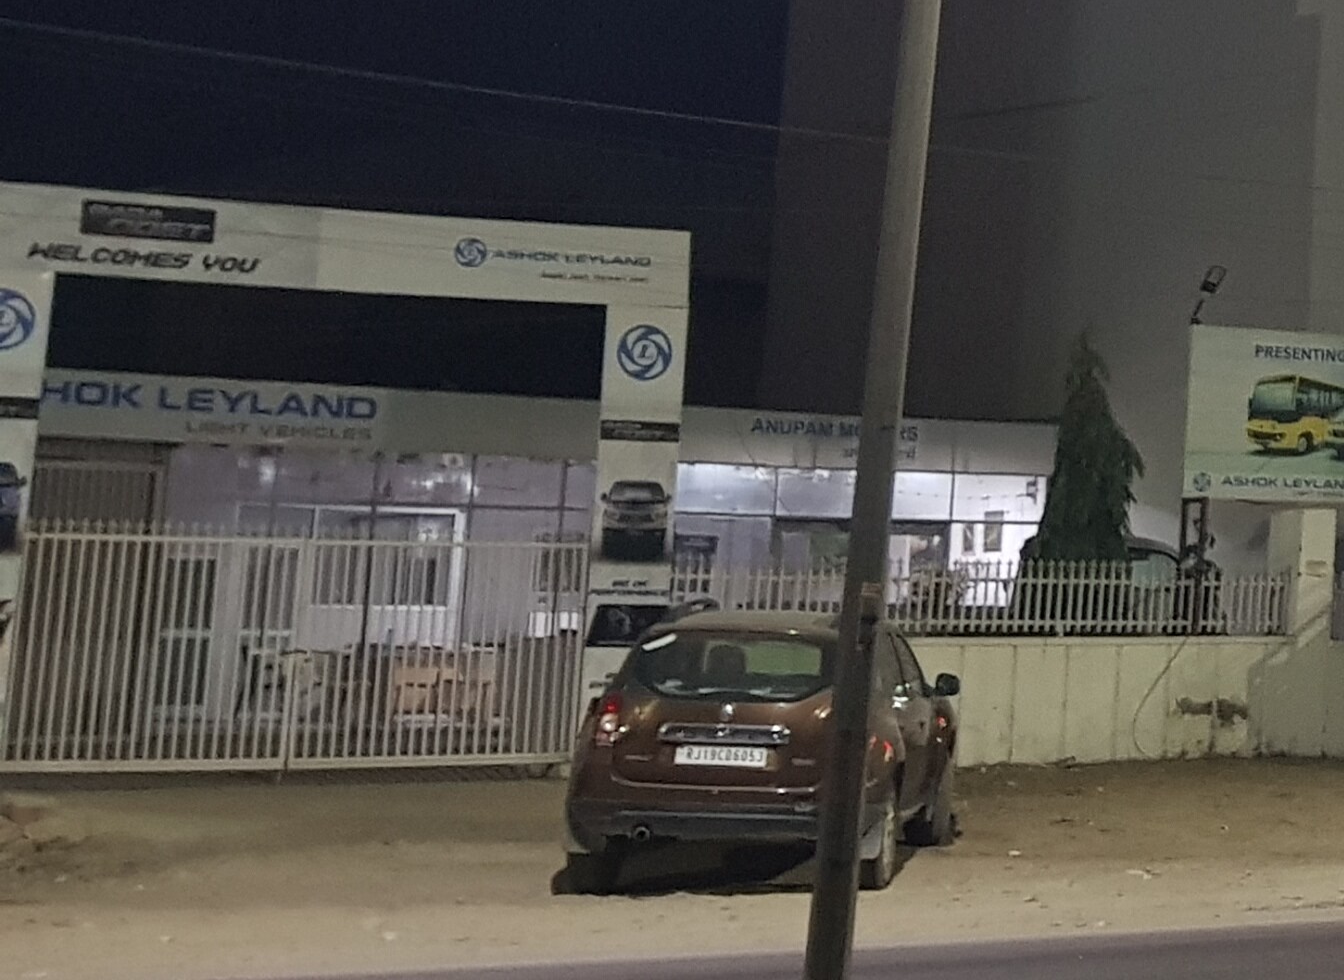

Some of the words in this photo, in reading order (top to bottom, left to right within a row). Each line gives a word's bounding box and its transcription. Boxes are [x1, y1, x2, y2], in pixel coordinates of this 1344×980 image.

[27, 242, 193, 269] WELCOMES
[202, 254, 261, 273] YOU
[492, 250, 559, 262] ASHOK
[565, 254, 652, 267] LEYLAND
[158, 386, 378, 419] LEYLAND
[1221, 476, 1278, 487] ASHOK
